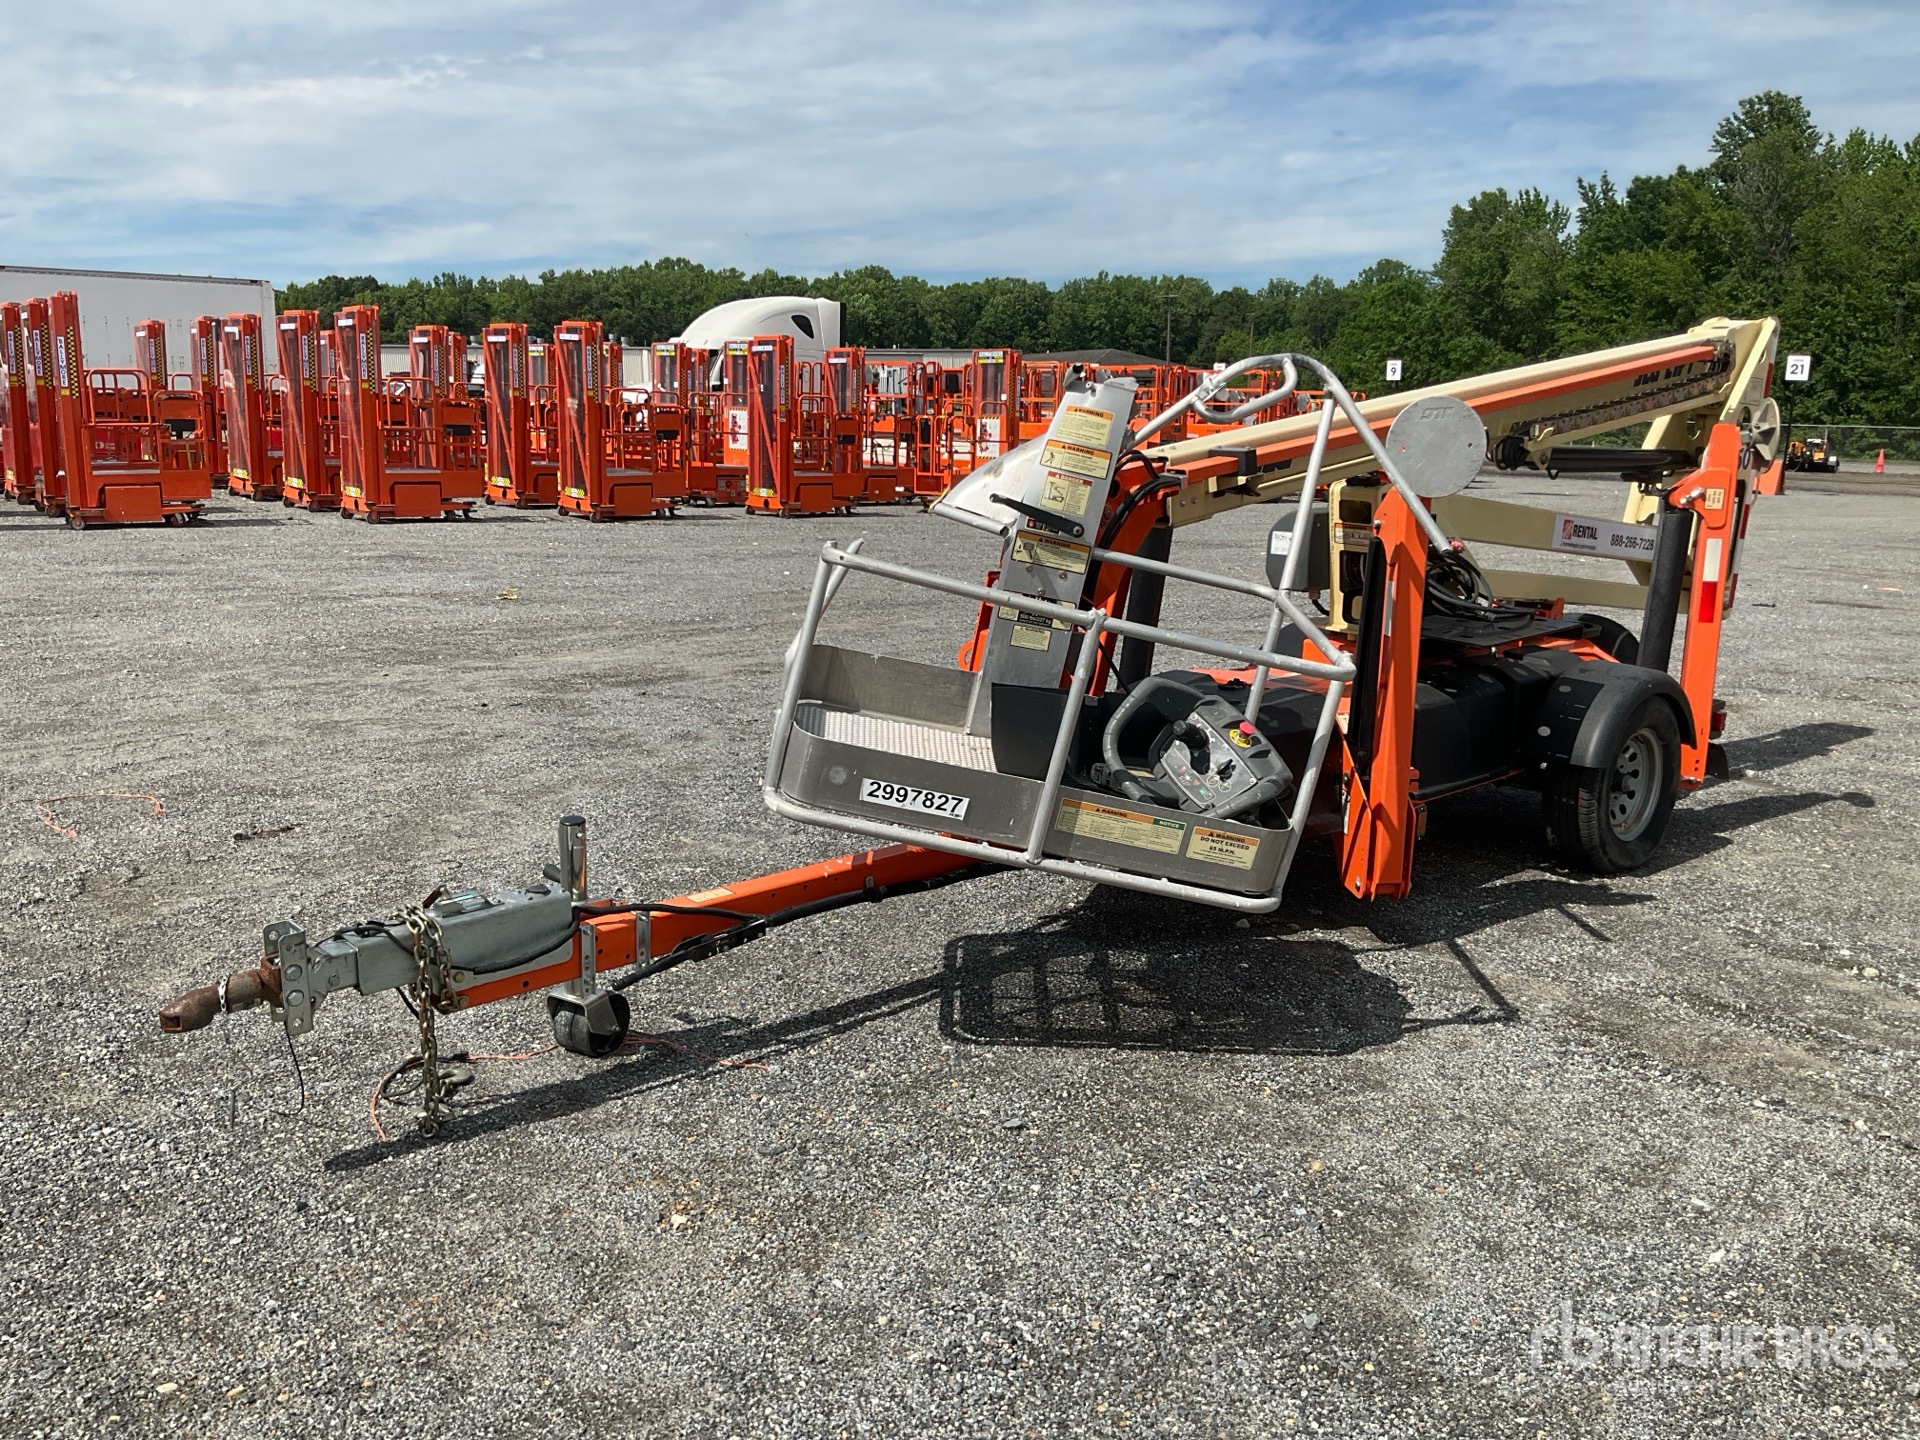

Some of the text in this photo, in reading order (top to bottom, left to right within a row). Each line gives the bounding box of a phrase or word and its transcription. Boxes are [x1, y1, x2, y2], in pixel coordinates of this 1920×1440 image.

[34, 332, 42, 375] BALLYMORE
[58, 338, 67, 386] BALLYMORE
[1390, 366, 1397, 376] 9
[1790, 363, 1805, 375] 21
[1078, 408, 1104, 418] WARNING
[1066, 445, 1094, 456] WARNING
[1060, 474, 1084, 484] DANGER
[1573, 524, 1598, 540] RENTAL
[1044, 539, 1071, 549] WARNING
[1610, 533, 1654, 551] 888-266-7228
[867, 781, 963, 813] 2997827
[1101, 808, 1128, 818] WARNING
[1159, 820, 1180, 829] NOTICE
[1215, 833, 1246, 844] WARNING
[1225, 841, 1250, 851] EXCEED
